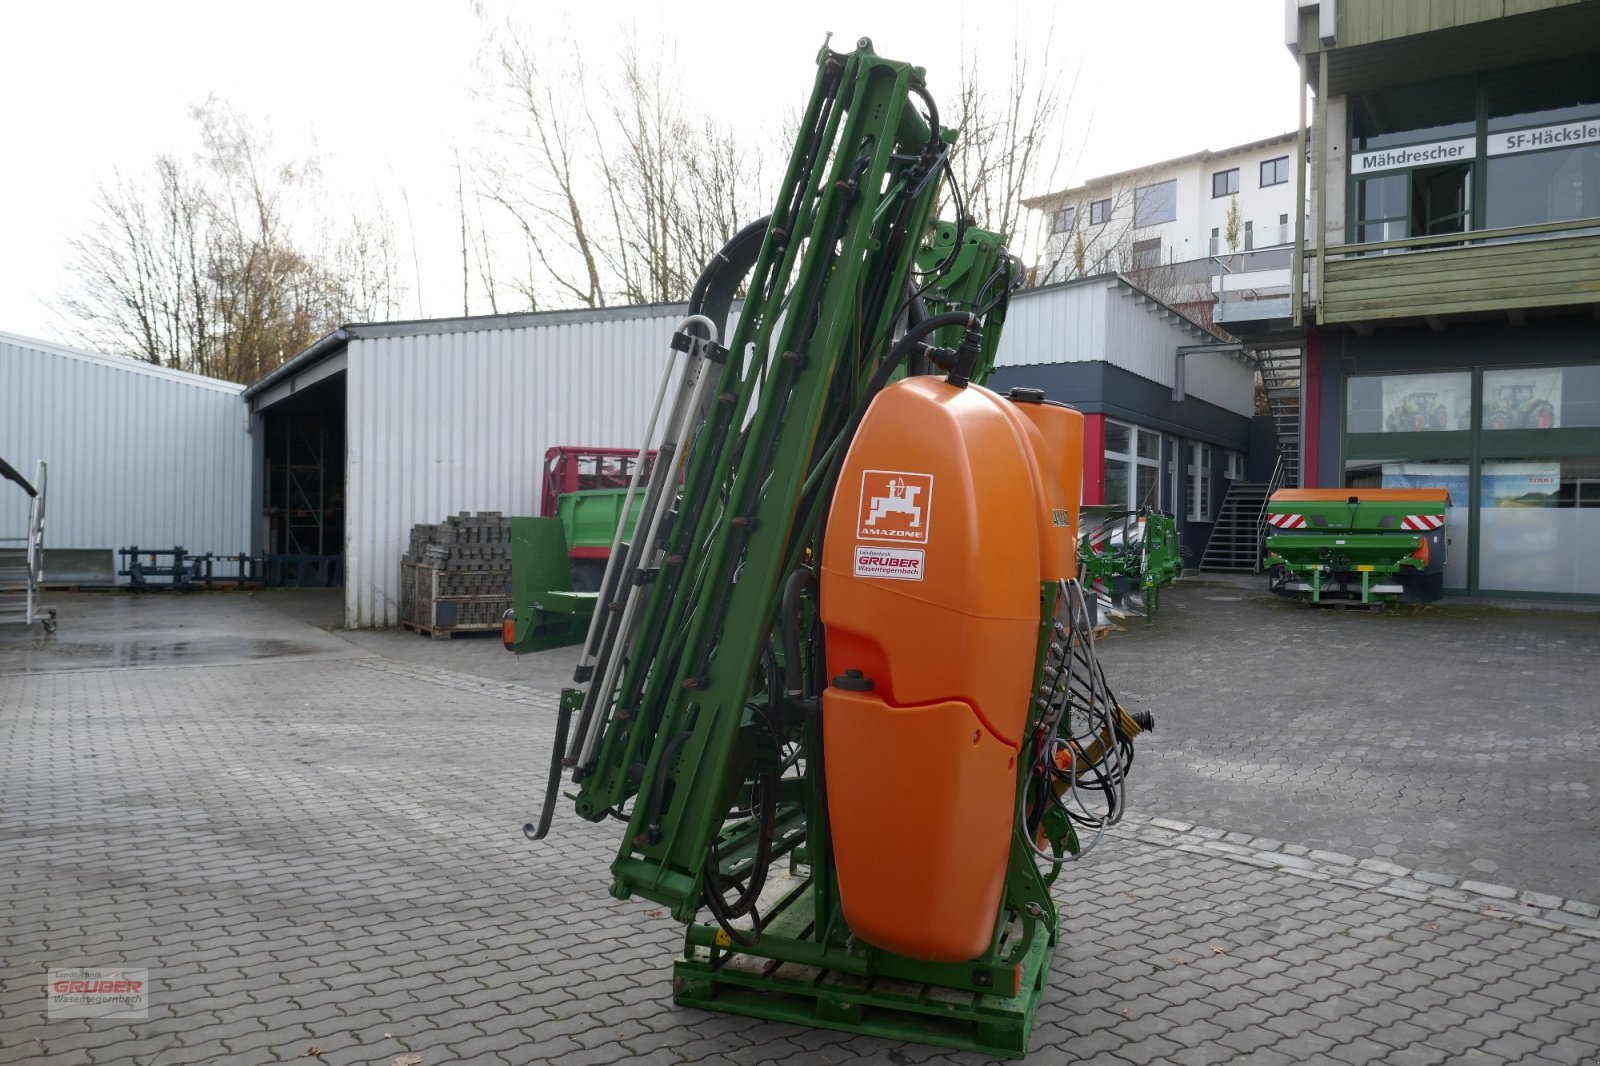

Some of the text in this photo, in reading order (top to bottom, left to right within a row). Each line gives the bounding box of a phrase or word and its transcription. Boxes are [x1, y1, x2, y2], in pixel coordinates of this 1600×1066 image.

[1362, 143, 1465, 169] Mähdrescher
[861, 528, 924, 538] AMAZONE
[858, 556, 920, 568] GRUBER
[858, 565, 919, 575] Wasentegernbach
